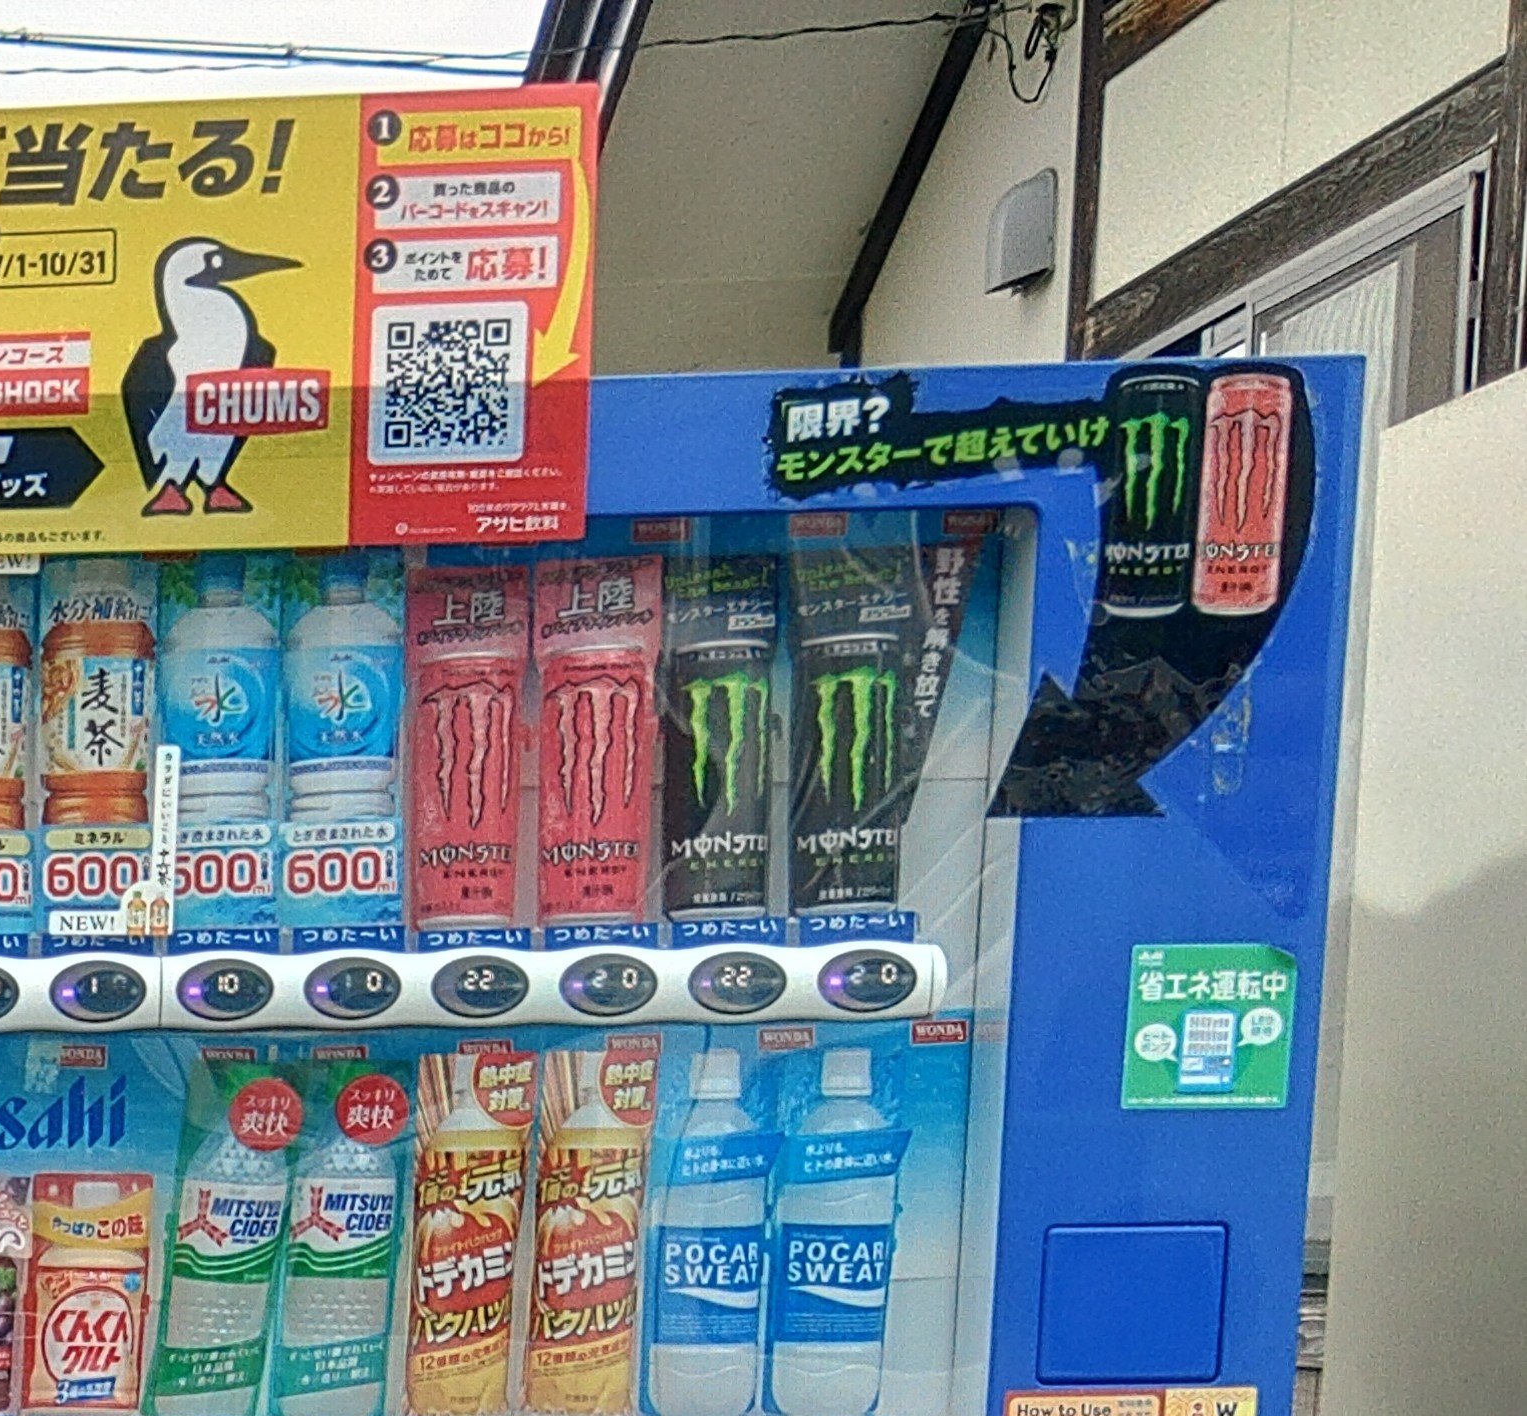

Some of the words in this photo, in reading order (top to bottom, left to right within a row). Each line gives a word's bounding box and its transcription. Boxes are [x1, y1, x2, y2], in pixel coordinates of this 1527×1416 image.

[466, 247, 546, 281] 応募!
[195, 379, 321, 426] CHUMS
[59, 914, 115, 932] NEW!
[1137, 971, 1288, 1001] 省エネ運転中
[239, 1112, 290, 1136] 爽快
[787, 1259, 885, 1283] SWEAT
